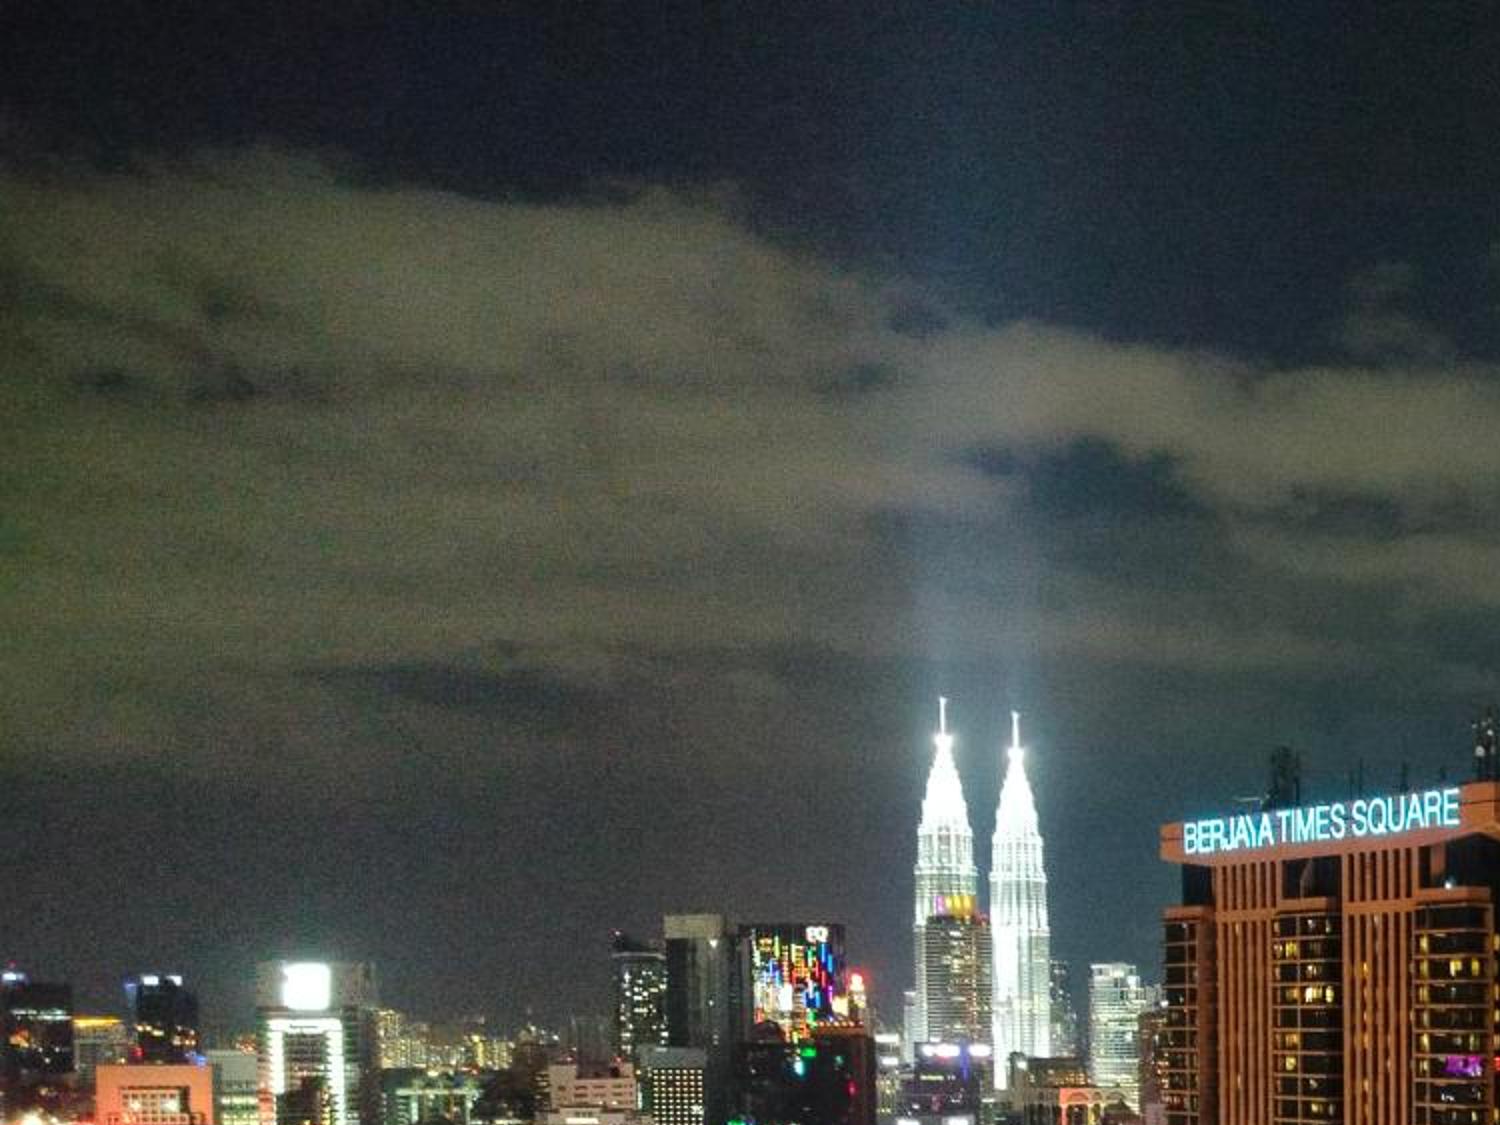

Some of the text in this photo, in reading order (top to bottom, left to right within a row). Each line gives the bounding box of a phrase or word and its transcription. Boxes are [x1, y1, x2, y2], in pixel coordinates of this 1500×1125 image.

[1184, 788, 1461, 855] BERJAYA TIMES SQUARE
